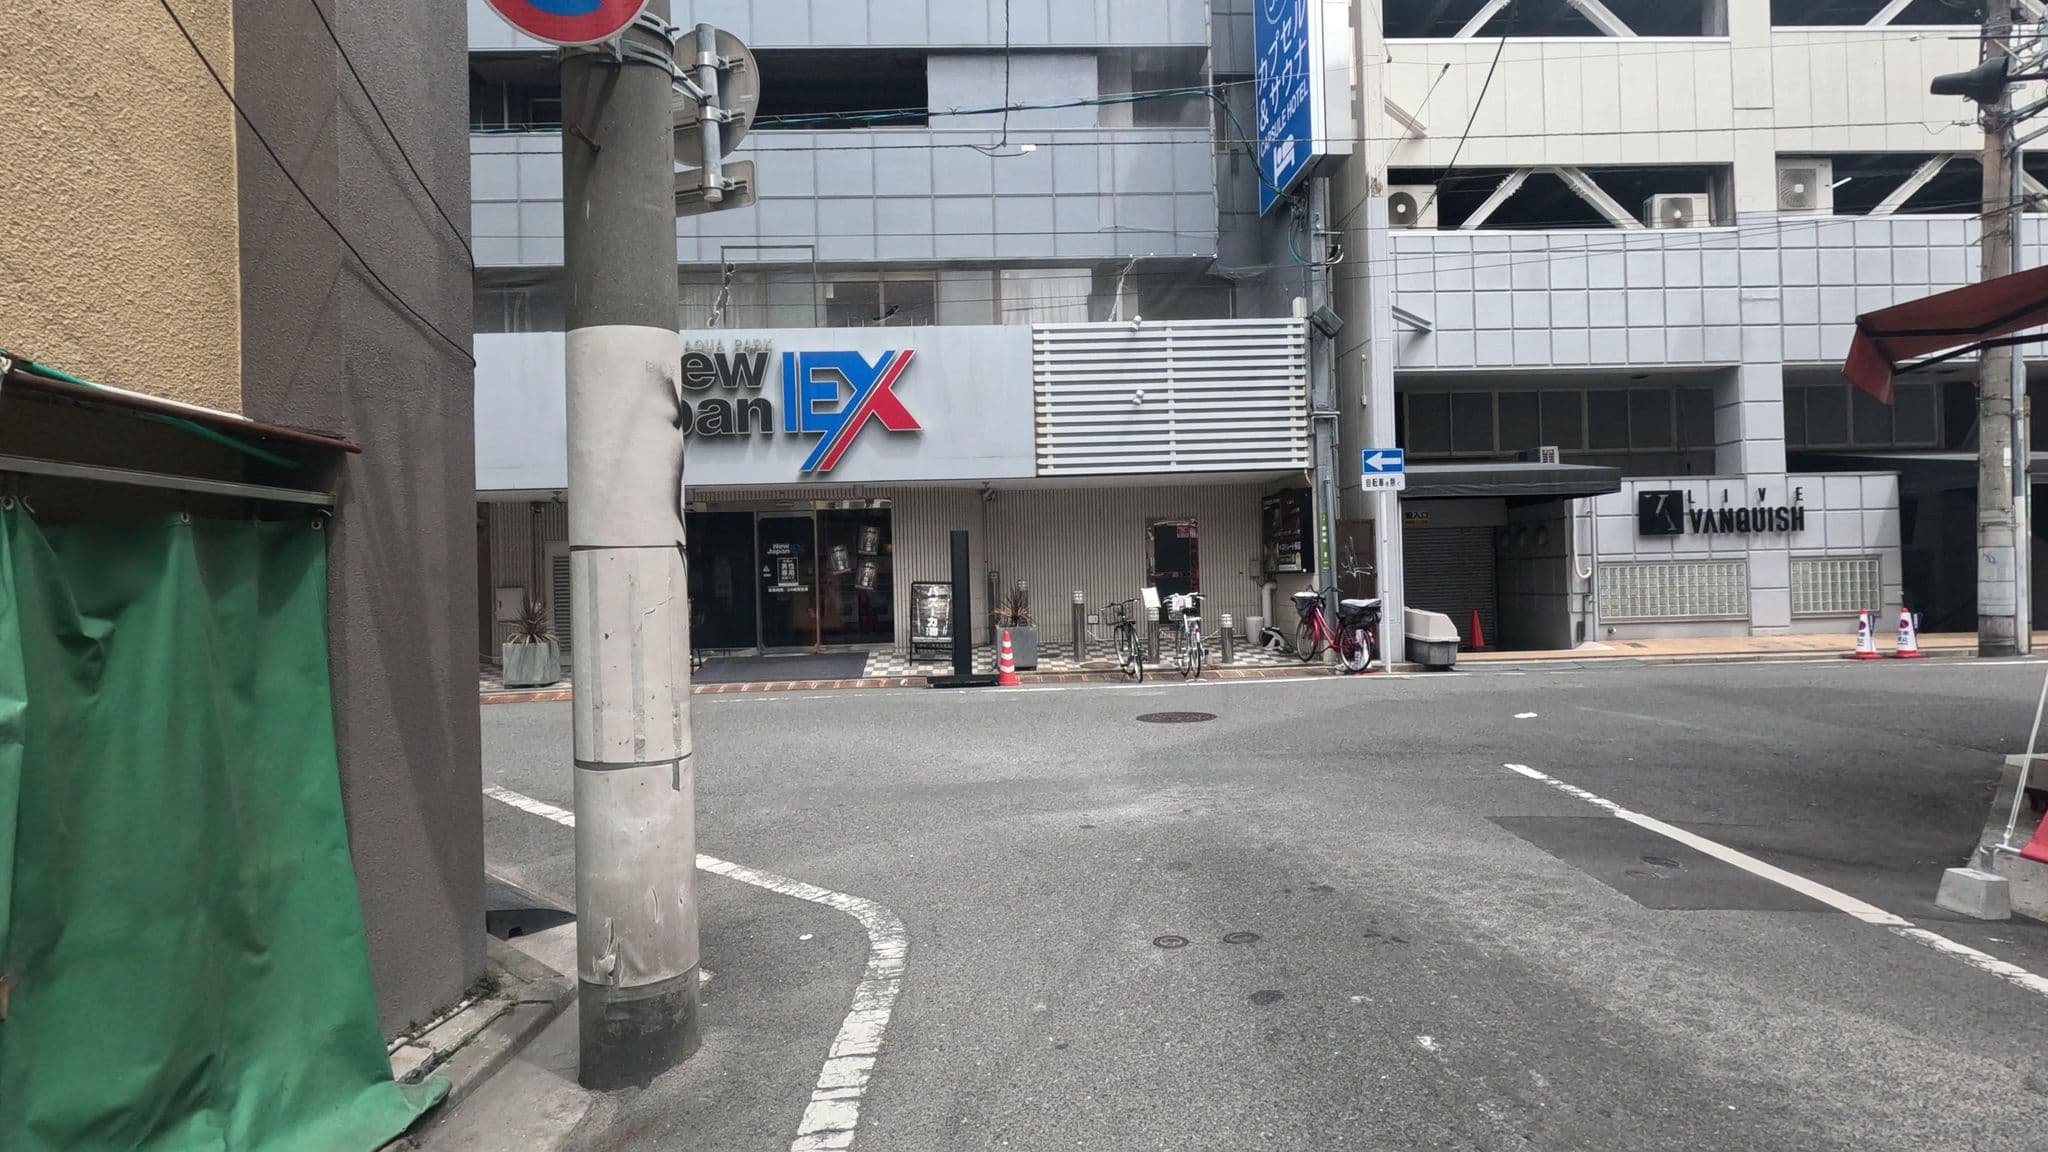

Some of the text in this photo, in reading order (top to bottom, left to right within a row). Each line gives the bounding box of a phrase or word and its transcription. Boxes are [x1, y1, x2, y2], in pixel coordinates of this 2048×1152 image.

[1258, 0, 1306, 95] カプセル
[1270, 38, 1307, 114] サウナ
[1260, 80, 1308, 157] CAPSULE HOTEL
[681, 350, 772, 390] ew
[1688, 487, 1804, 504] LIVE
[1689, 506, 1805, 534] VANQUISH
